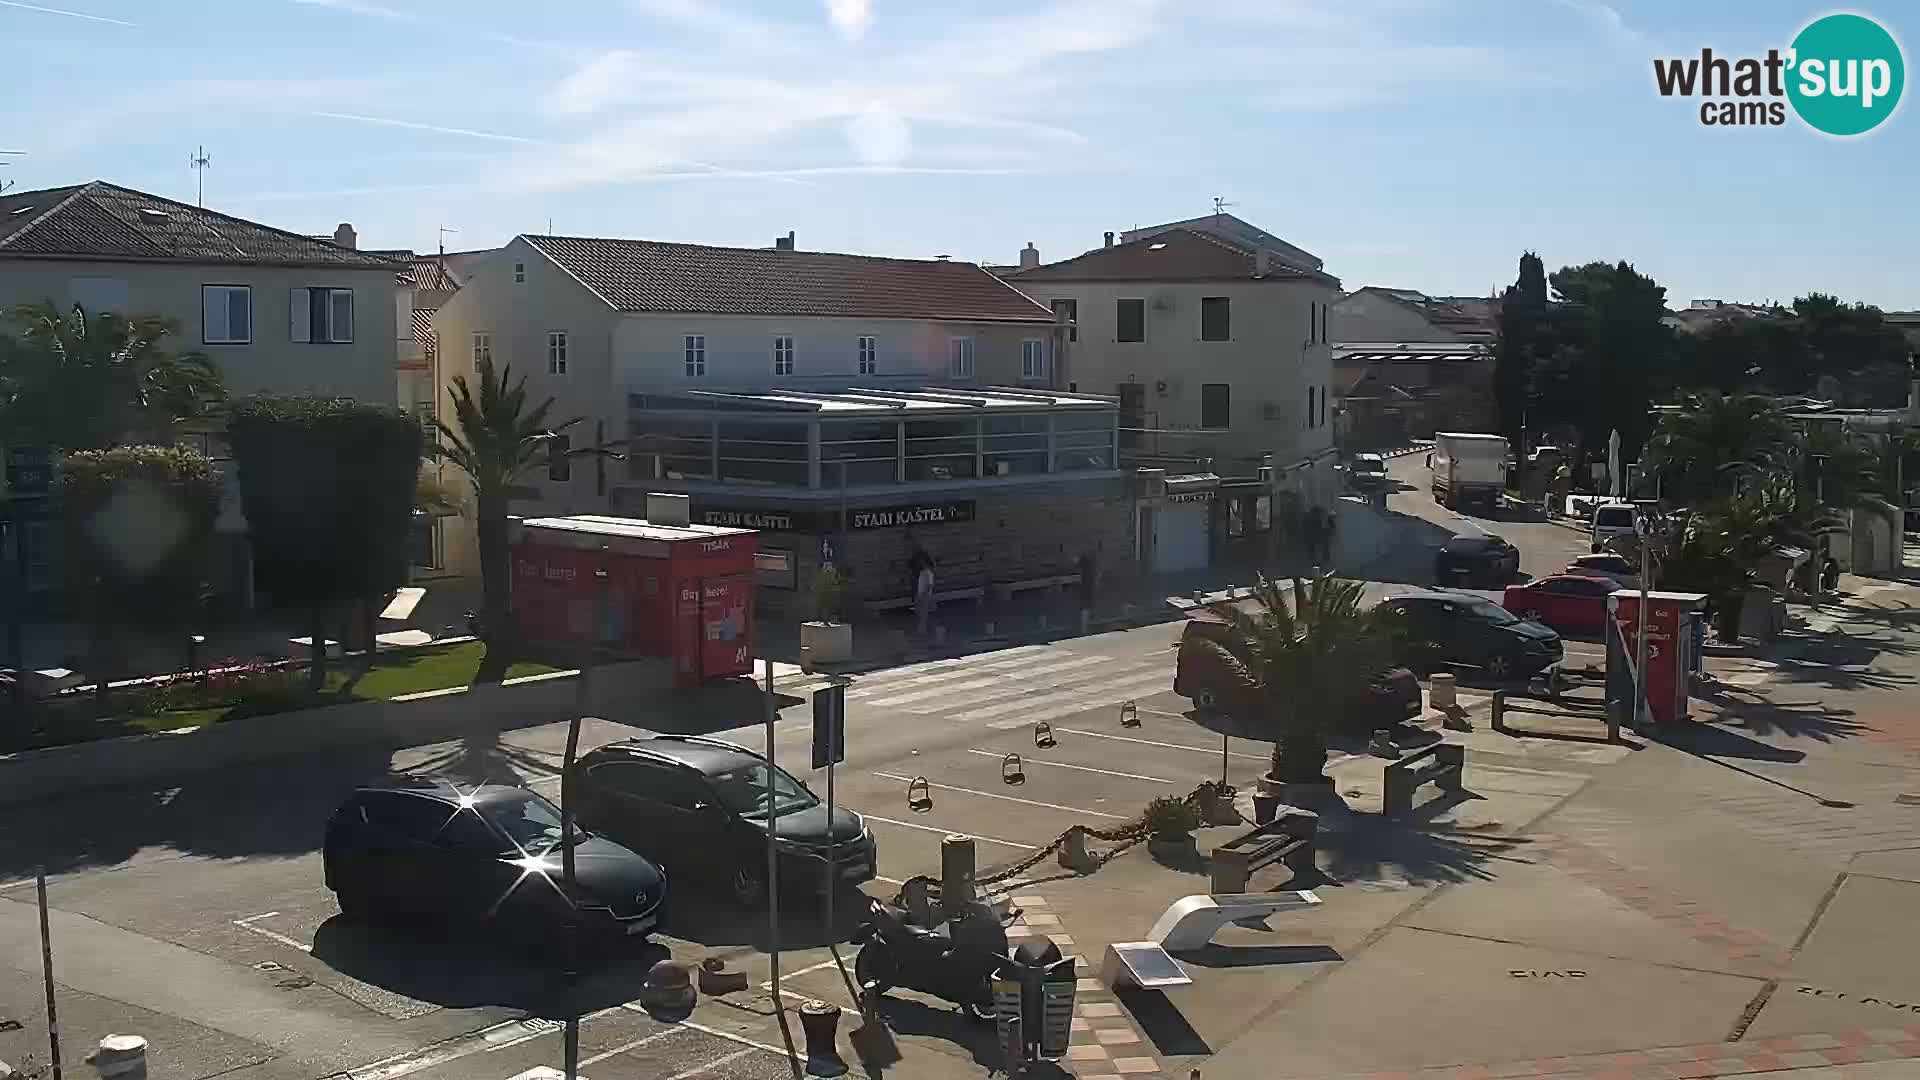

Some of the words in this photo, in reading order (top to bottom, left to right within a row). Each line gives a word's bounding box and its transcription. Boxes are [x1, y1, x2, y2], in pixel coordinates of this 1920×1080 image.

[854, 511, 893, 528] STARI
[896, 507, 945, 525] KAŠTEL
[701, 539, 730, 552] TISAK
